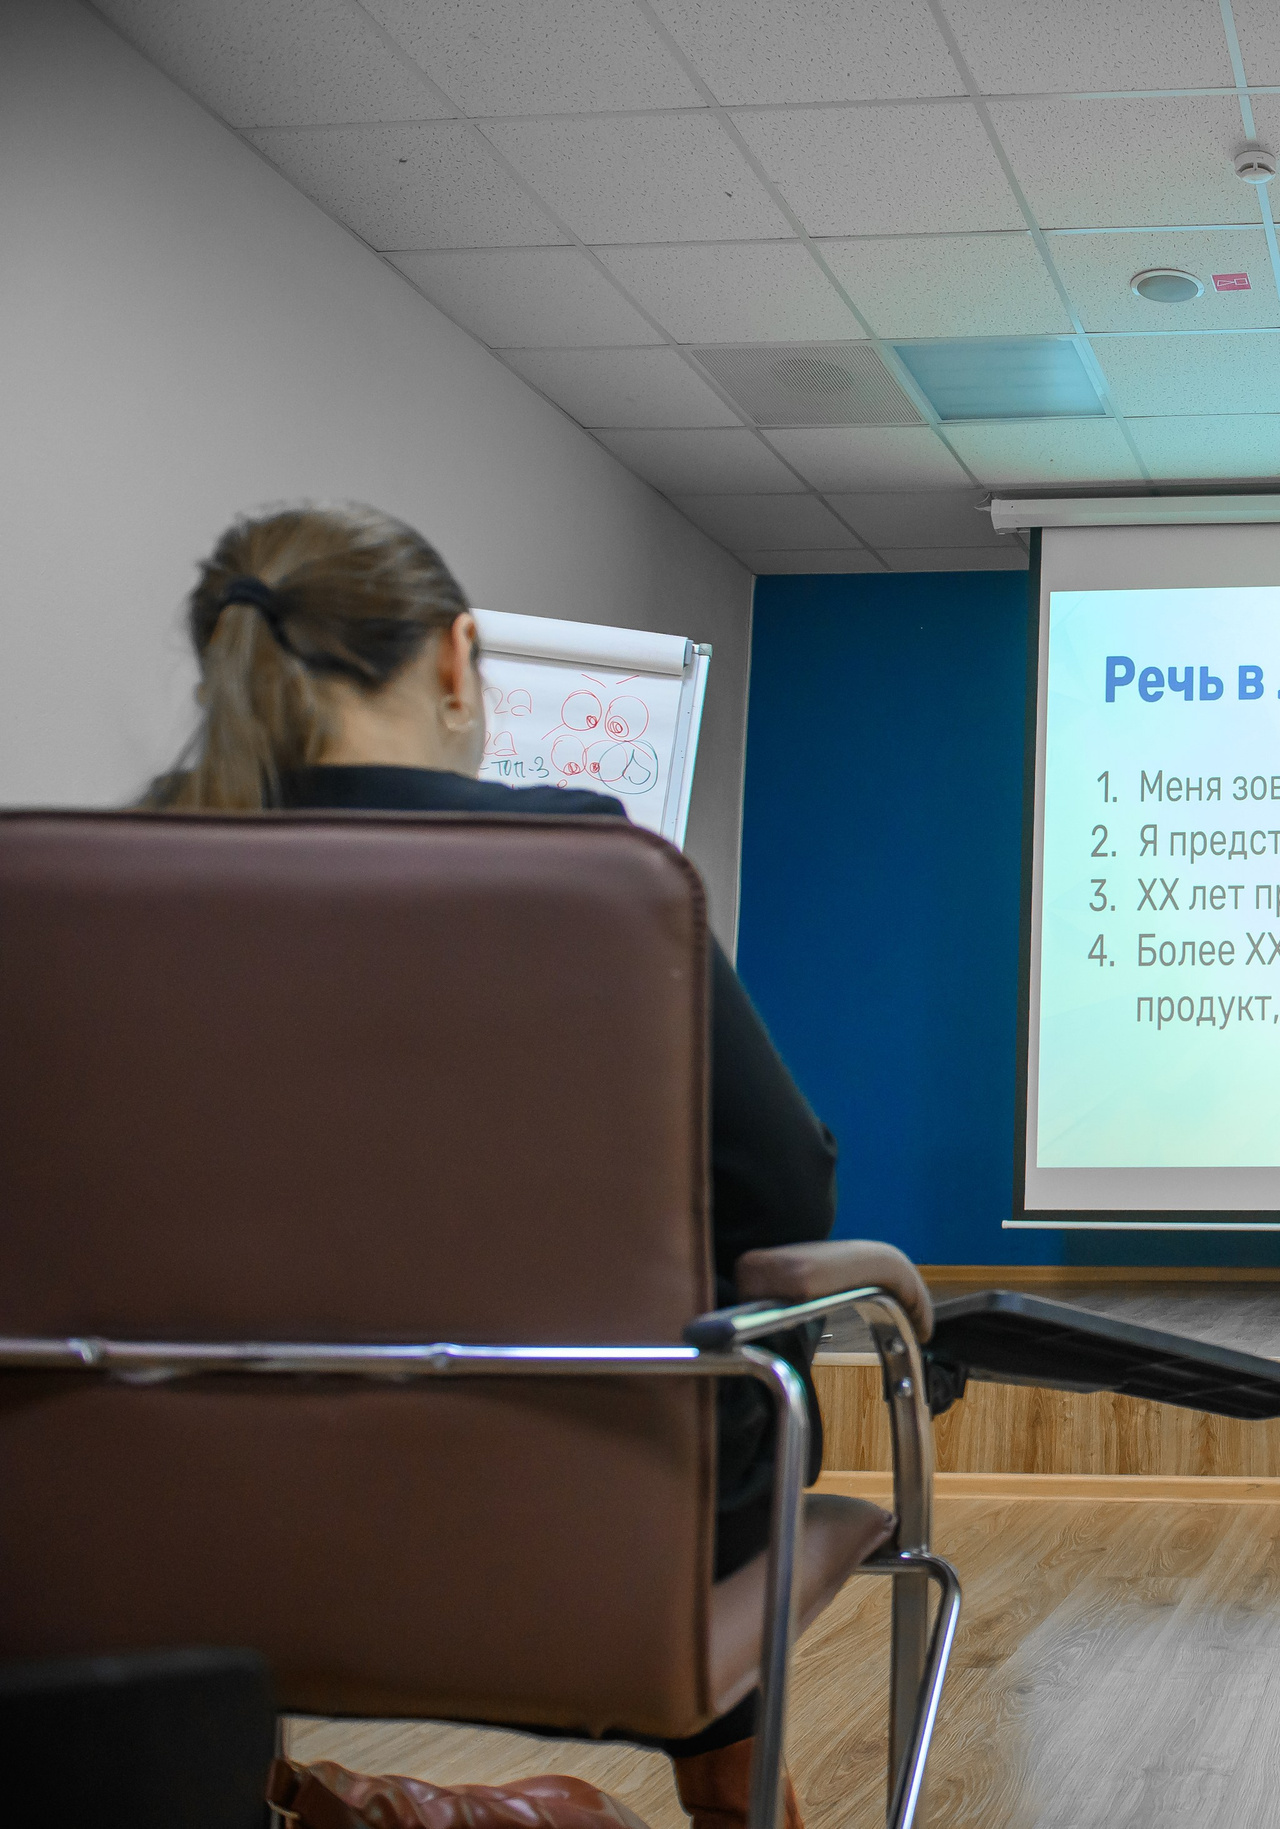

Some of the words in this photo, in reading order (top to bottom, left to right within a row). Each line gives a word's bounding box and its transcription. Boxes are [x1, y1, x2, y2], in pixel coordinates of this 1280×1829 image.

[1104, 655, 1225, 704] Речь
[1237, 663, 1266, 702] в
[1096, 769, 1118, 803] 1.
[1140, 769, 1222, 803] Меня
[1090, 823, 1117, 858] 2.
[1138, 823, 1158, 857] Я
[1088, 878, 1117, 912] 3.
[1188, 883, 1246, 912] лет
[1087, 933, 1116, 968] 4.
[1137, 932, 1235, 967] Более
[1136, 994, 1280, 1031] продукт,
